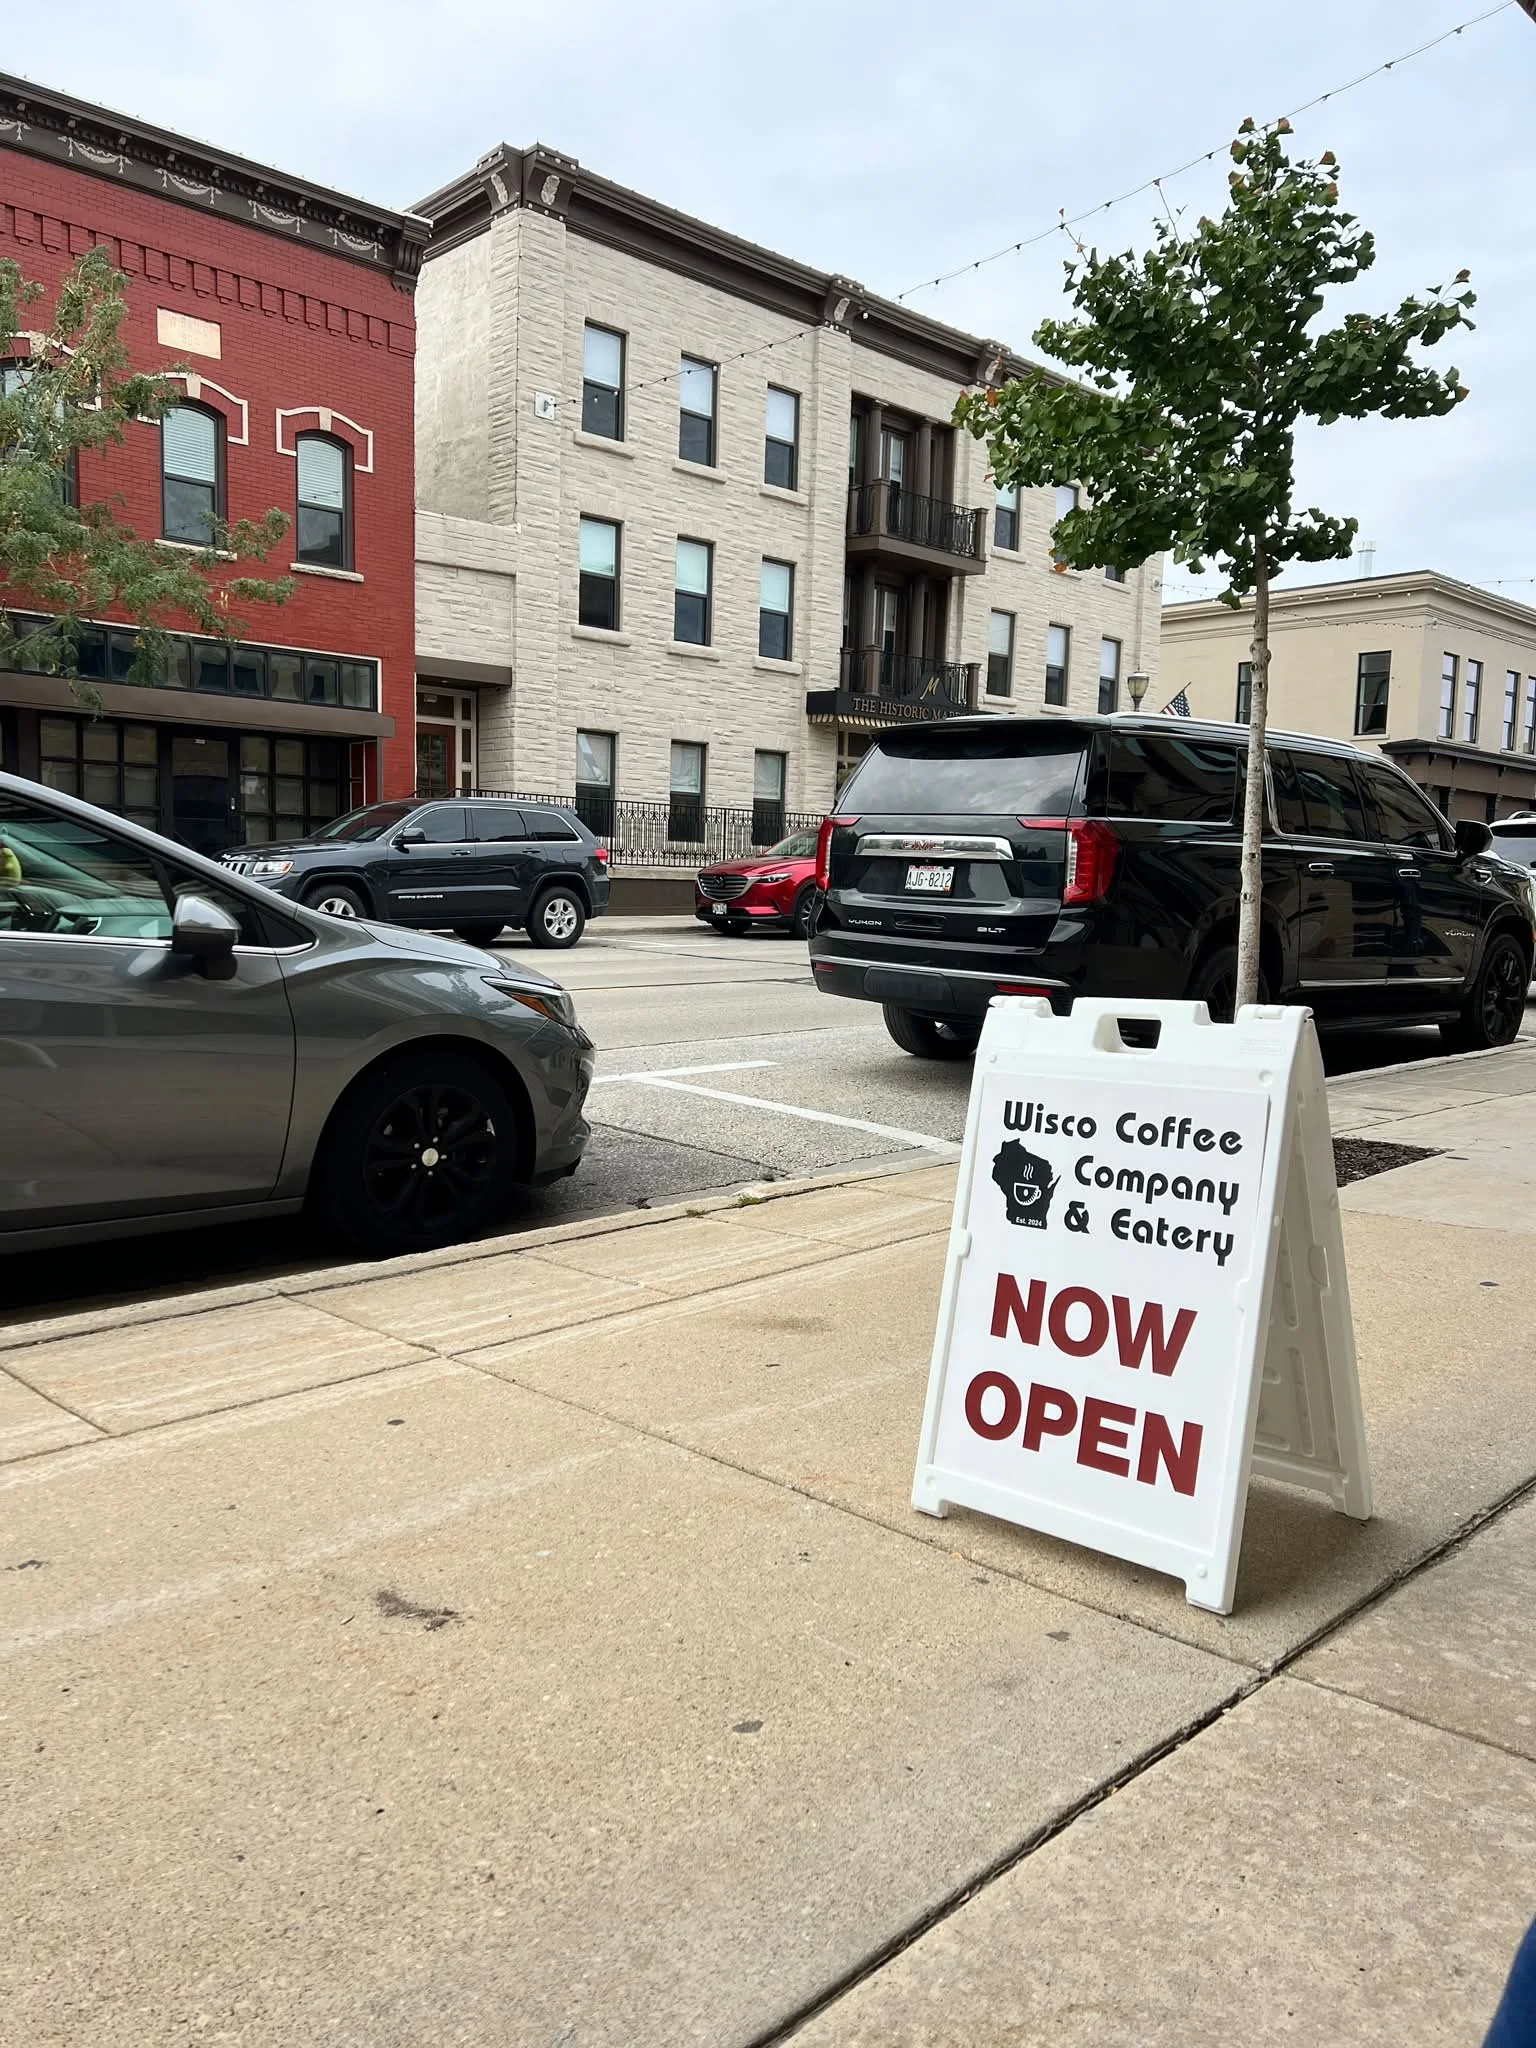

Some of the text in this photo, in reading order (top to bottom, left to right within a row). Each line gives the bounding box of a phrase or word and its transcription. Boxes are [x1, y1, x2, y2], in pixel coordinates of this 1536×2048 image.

[853, 697, 876, 713] THE
[879, 701, 929, 720] HISTORIC
[905, 871, 952, 888] AJG-8212
[848, 918, 882, 926] YUKON
[976, 926, 1006, 934] SLT
[1003, 1100, 1243, 1155] Wisco Coffee
[1074, 1155, 1240, 1216] Company
[1015, 1216, 1043, 1227] Est. 2024
[1064, 1200, 1234, 1267] & Eatery
[990, 1272, 1198, 1377] NOW
[965, 1370, 1203, 1497] OPEN
